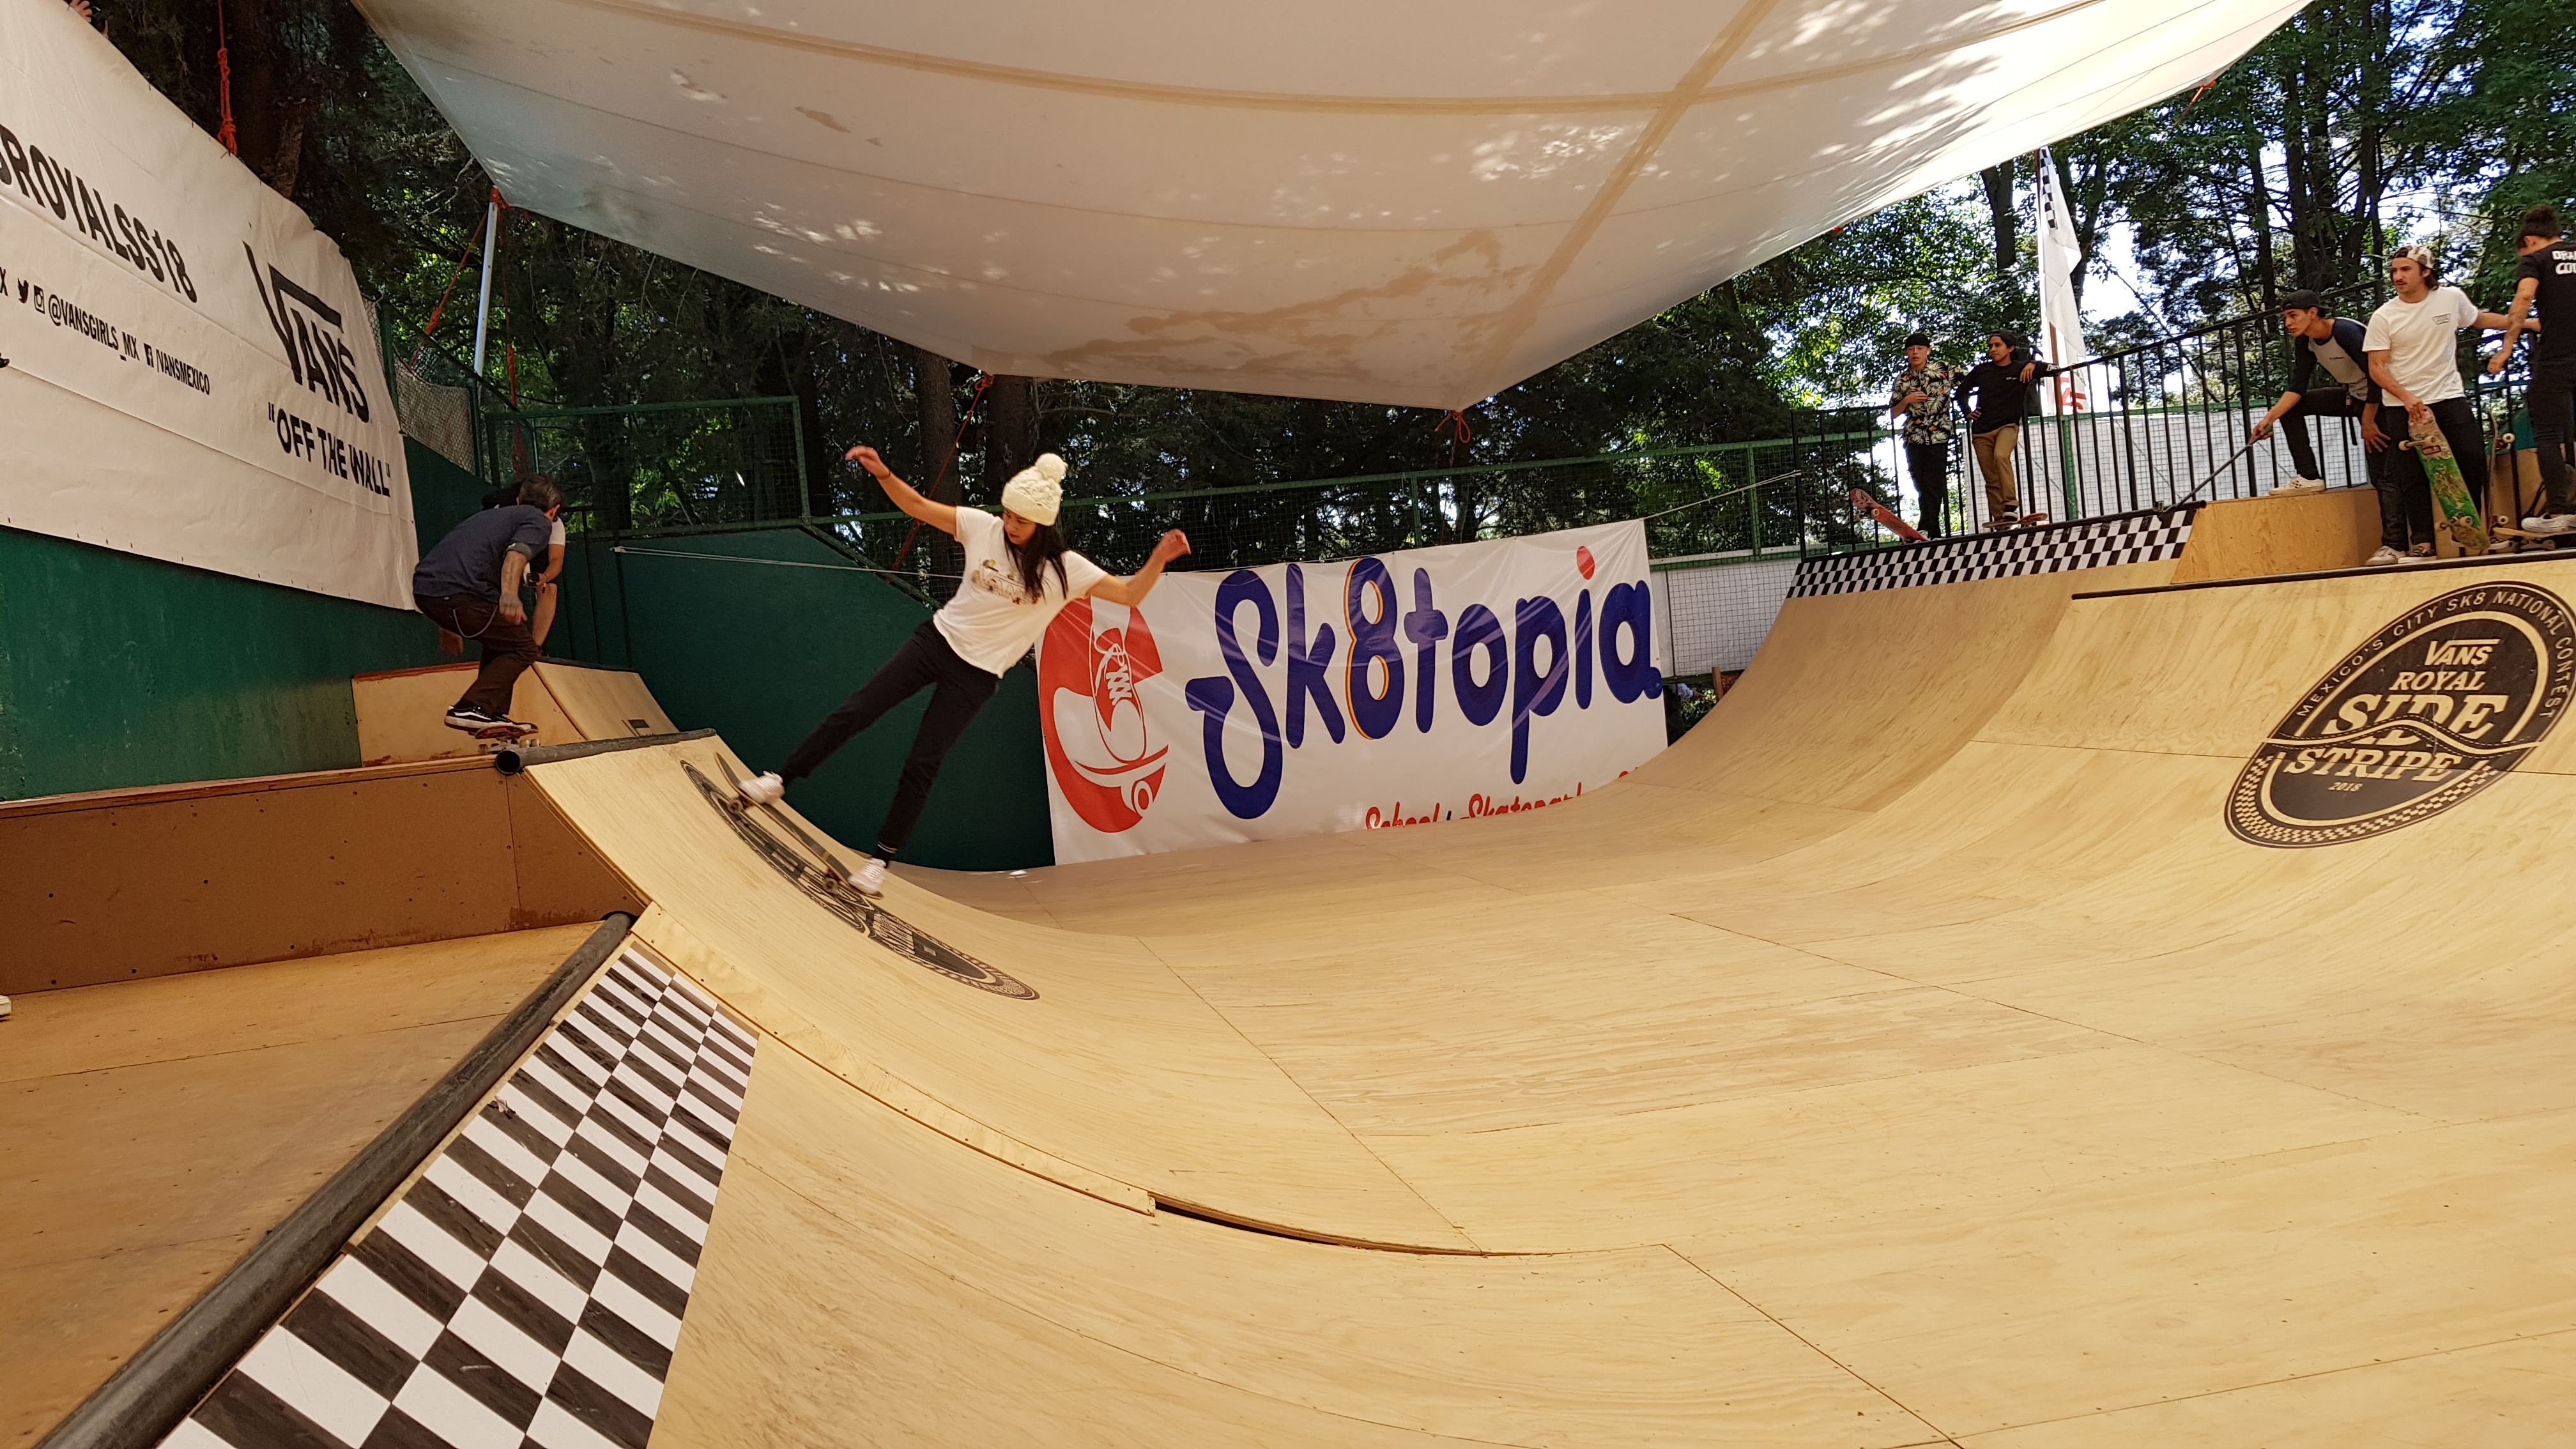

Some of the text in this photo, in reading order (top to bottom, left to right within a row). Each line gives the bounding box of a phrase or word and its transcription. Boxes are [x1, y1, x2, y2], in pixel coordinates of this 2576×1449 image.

[49, 295, 140, 361] @VANSGIRLS_MX
[242, 240, 369, 423] VANS
[268, 401, 390, 497] "OFF THE WALL"
[2296, 591, 2573, 719] MEXICO'S CITY SK8 NATIONAL CONTEST
[2389, 671, 2487, 691] ROYAL
[2425, 639, 2501, 666] VANS
[1186, 546, 1662, 819] Sk8topia
[2320, 694, 2509, 747] SIDE
[2283, 747, 2463, 782] STRIPE
[2327, 781, 2363, 792] 2018
